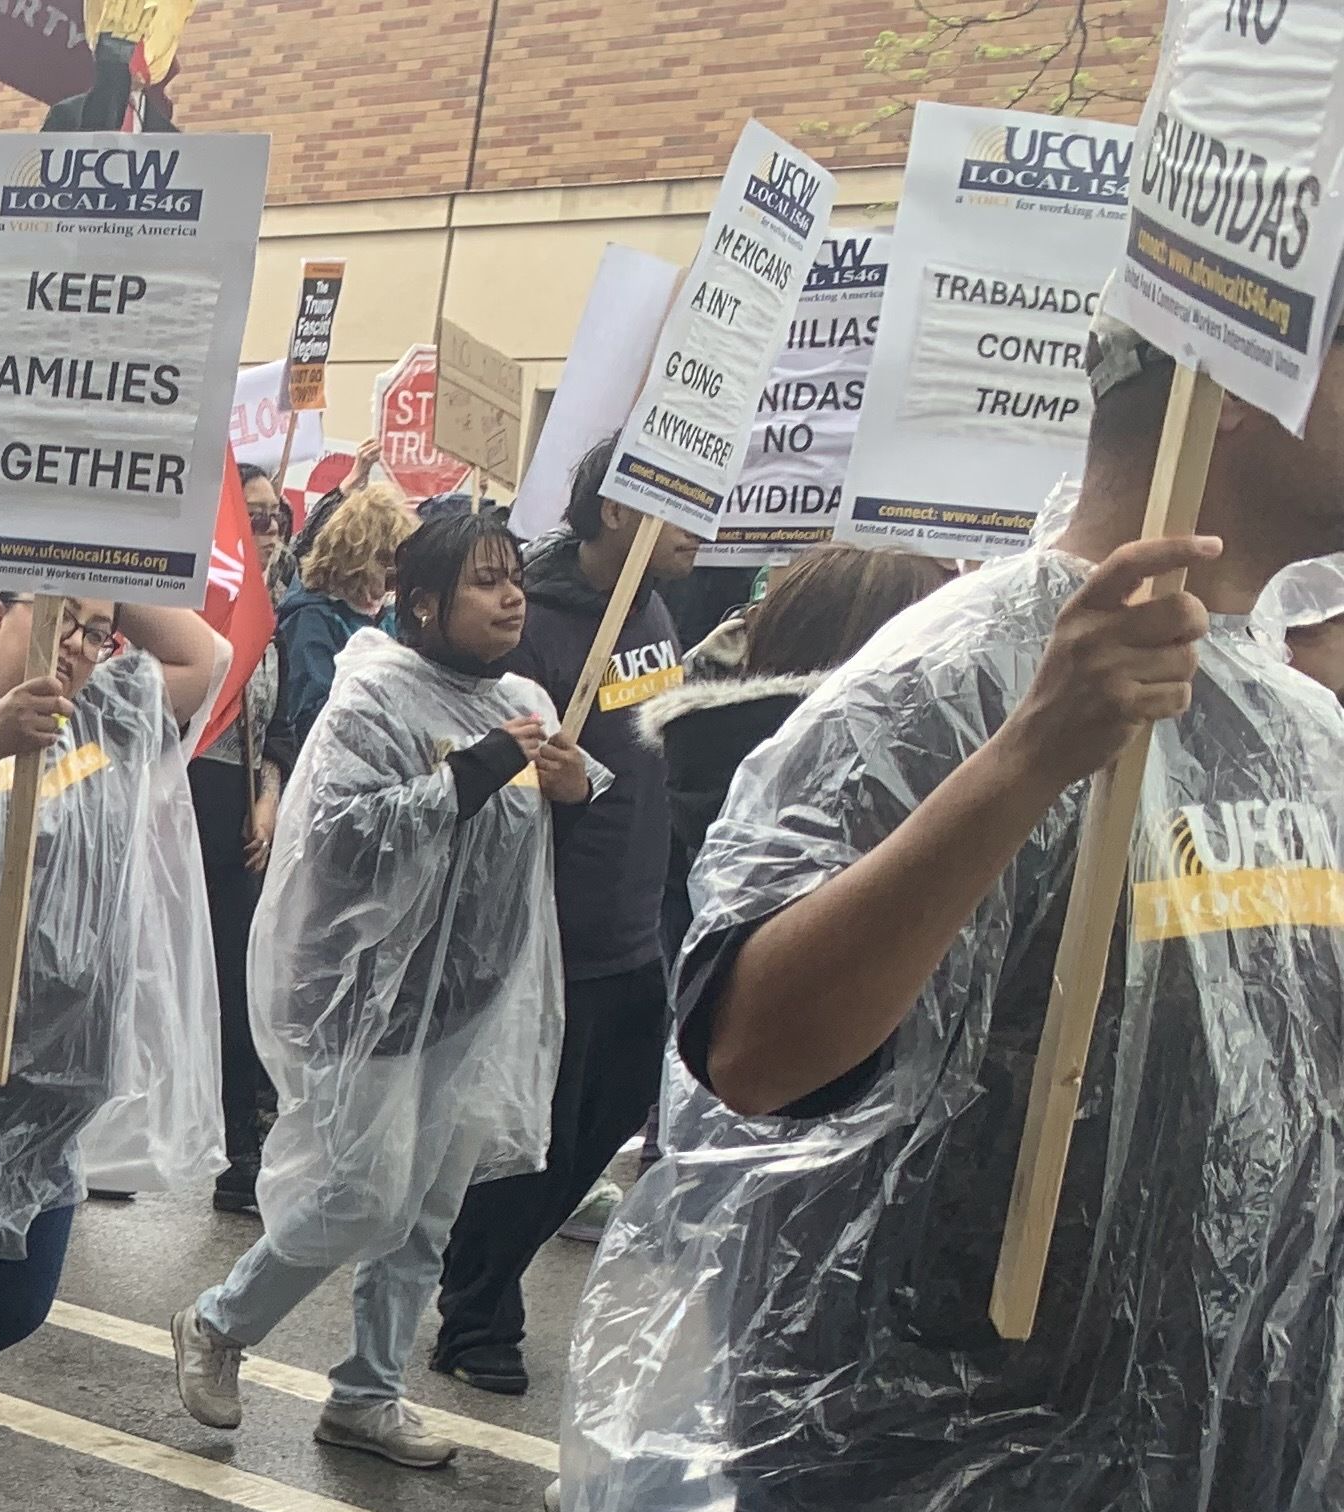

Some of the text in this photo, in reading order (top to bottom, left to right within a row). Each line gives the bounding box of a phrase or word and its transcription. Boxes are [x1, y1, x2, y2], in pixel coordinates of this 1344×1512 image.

[1005, 126, 1134, 176] UFCW
[39, 148, 181, 190] UFCW
[768, 151, 820, 209] UFCW
[968, 165, 1080, 193] LOCAL
[7, 192, 192, 214] LOCAL 1546
[749, 181, 810, 232] LOCAL 1546
[1141, 111, 1321, 271] DIVIDIDAS
[1016, 199, 1036, 211] for
[1039, 203, 1093, 219] working
[55, 222, 76, 234] for
[78, 222, 134, 238] working
[137, 223, 198, 237] America
[714, 223, 792, 291] MEXICANS
[26, 270, 148, 315] KEEP
[316, 280, 330, 295] The
[831, 268, 880, 285] 1546
[691, 281, 742, 325] AIN'T
[840, 289, 885, 301] America
[666, 351, 723, 400] GOING
[395, 389, 435, 426] ST
[758, 381, 865, 413] NIDAS
[976, 387, 1081, 423] TRUMP
[763, 423, 814, 453] NO
[878, 503, 938, 521] connect:
[855, 523, 888, 535] United
[890, 525, 915, 537] Food
[926, 527, 983, 543] Commercial
[984, 533, 1026, 547] Workers
[0, 541, 169, 572] www.ufcwlocal1546.org
[45, 567, 86, 582] Workers
[88, 571, 154, 588] International
[155, 577, 187, 591] Union
[611, 639, 677, 682] UFCW
